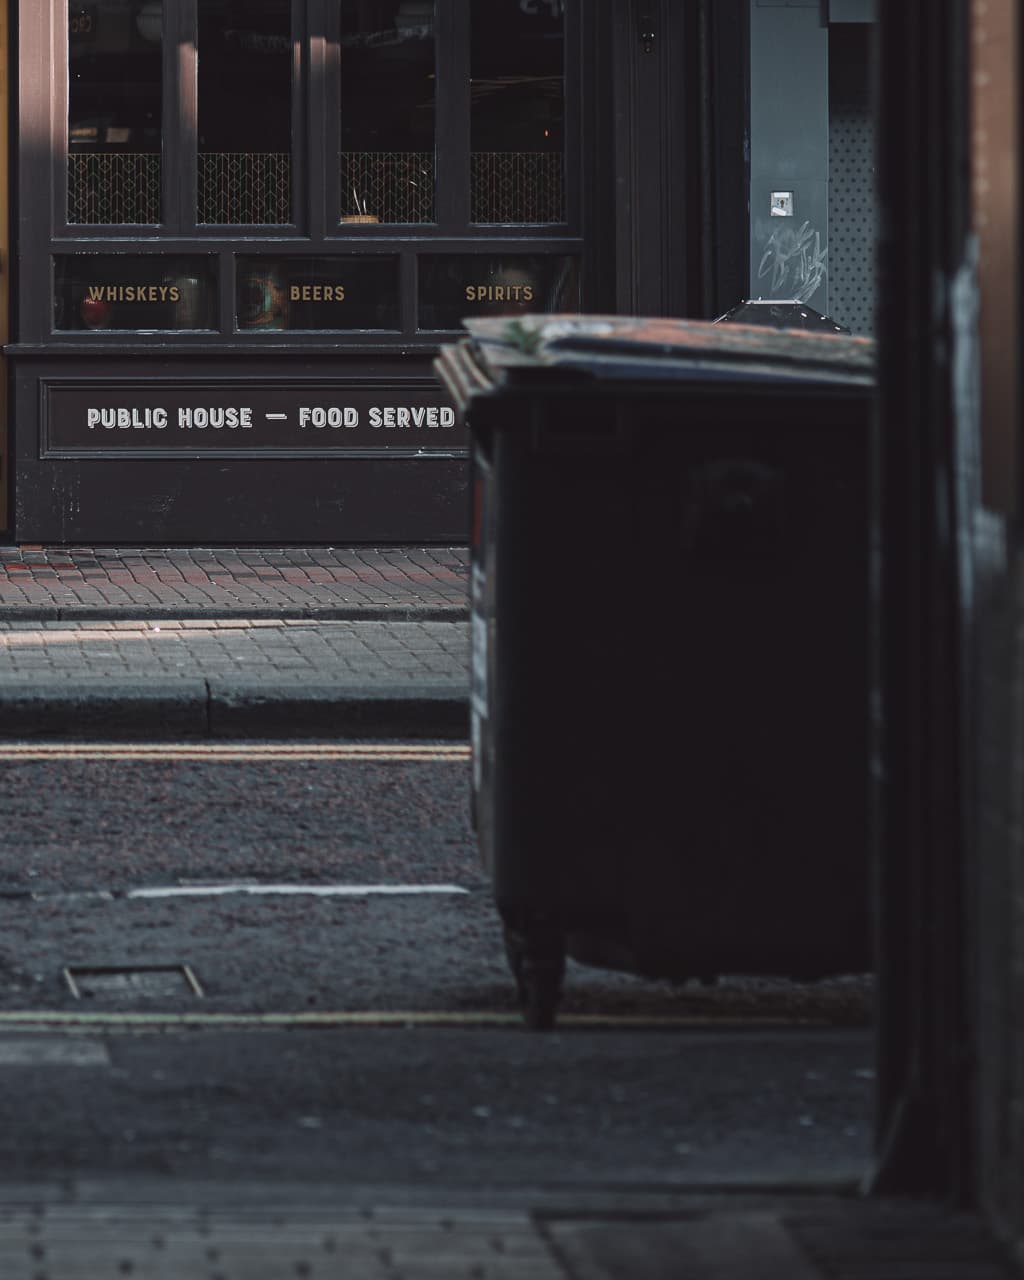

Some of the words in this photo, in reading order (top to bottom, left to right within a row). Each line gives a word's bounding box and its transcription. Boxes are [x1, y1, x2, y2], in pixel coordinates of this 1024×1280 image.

[89, 285, 181, 302] WHISKEYS
[290, 285, 345, 301] BEERS
[465, 285, 534, 301] SPIRITS
[87, 407, 168, 429] PUBLIC
[178, 407, 253, 429] HOUSE
[299, 407, 360, 429] FOOD
[368, 406, 456, 429] SERVED
